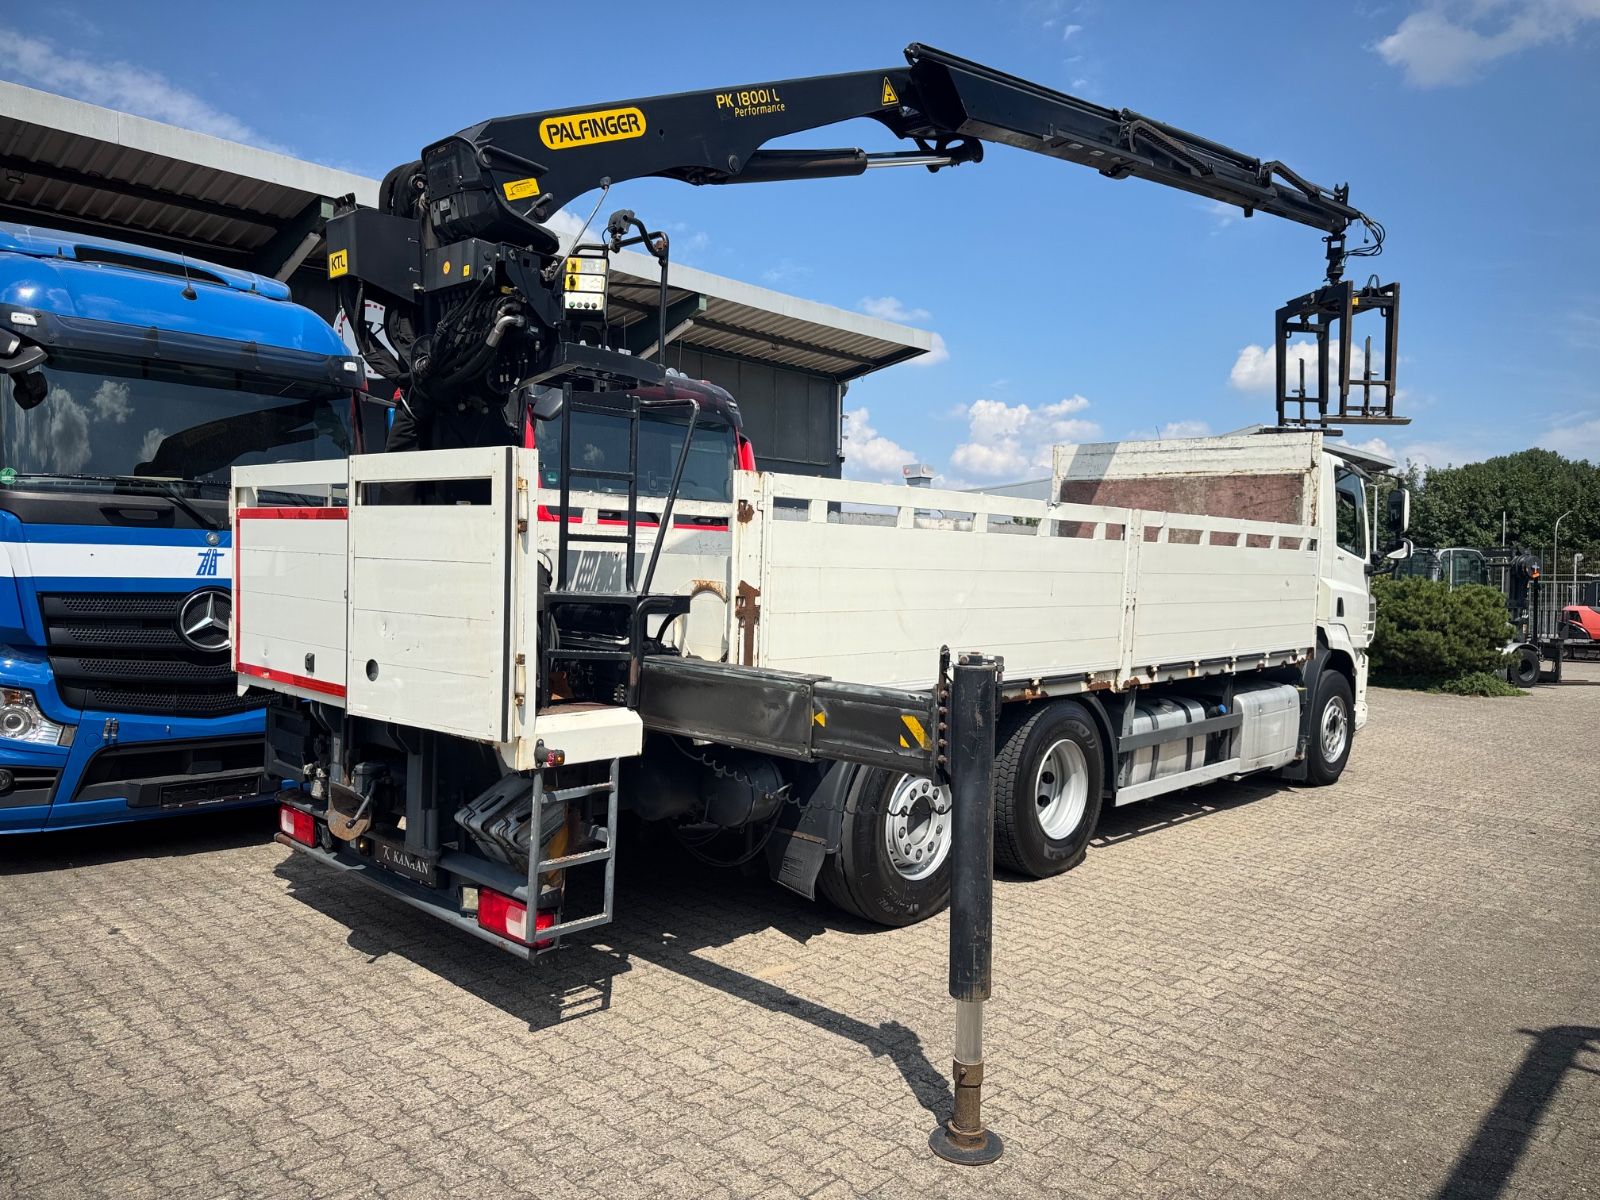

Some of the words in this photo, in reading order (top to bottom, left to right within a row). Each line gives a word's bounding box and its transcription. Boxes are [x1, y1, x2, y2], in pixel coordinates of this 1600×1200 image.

[715, 93, 735, 109] PK
[736, 89, 771, 106] 18001
[772, 87, 781, 102] L
[734, 103, 786, 118] Performance
[546, 113, 641, 144] PALFINGER
[331, 254, 346, 271] KTL
